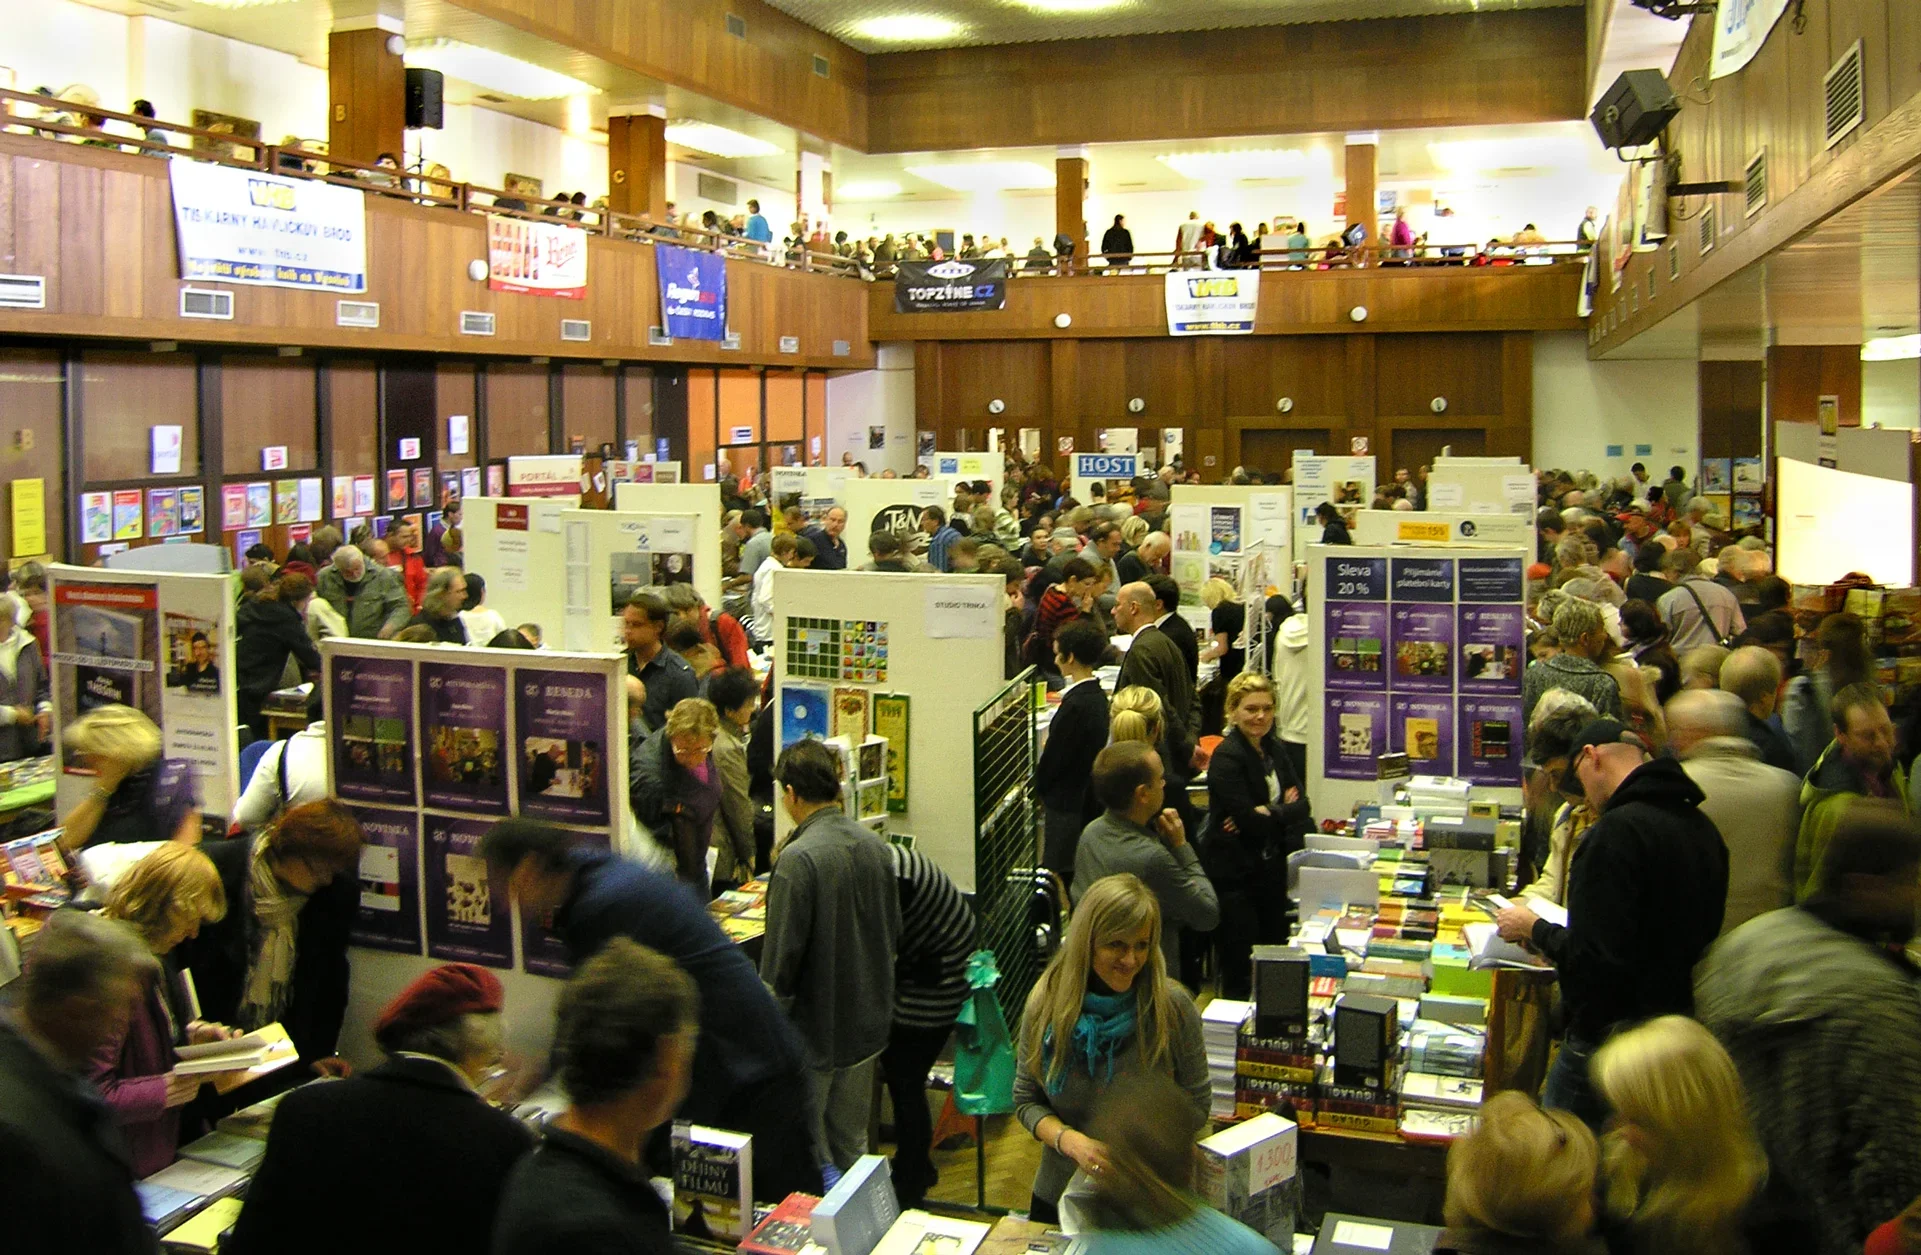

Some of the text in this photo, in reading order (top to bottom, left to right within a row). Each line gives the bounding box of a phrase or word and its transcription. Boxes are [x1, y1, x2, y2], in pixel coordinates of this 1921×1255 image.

[1080, 458, 1134, 473] HOST
[1337, 563, 1372, 578] Sleva
[1337, 582, 1370, 596] 20 %
[1429, 579, 1451, 591] karty
[544, 686, 593, 700] BESEDA
[681, 1174, 730, 1195] FILMU
